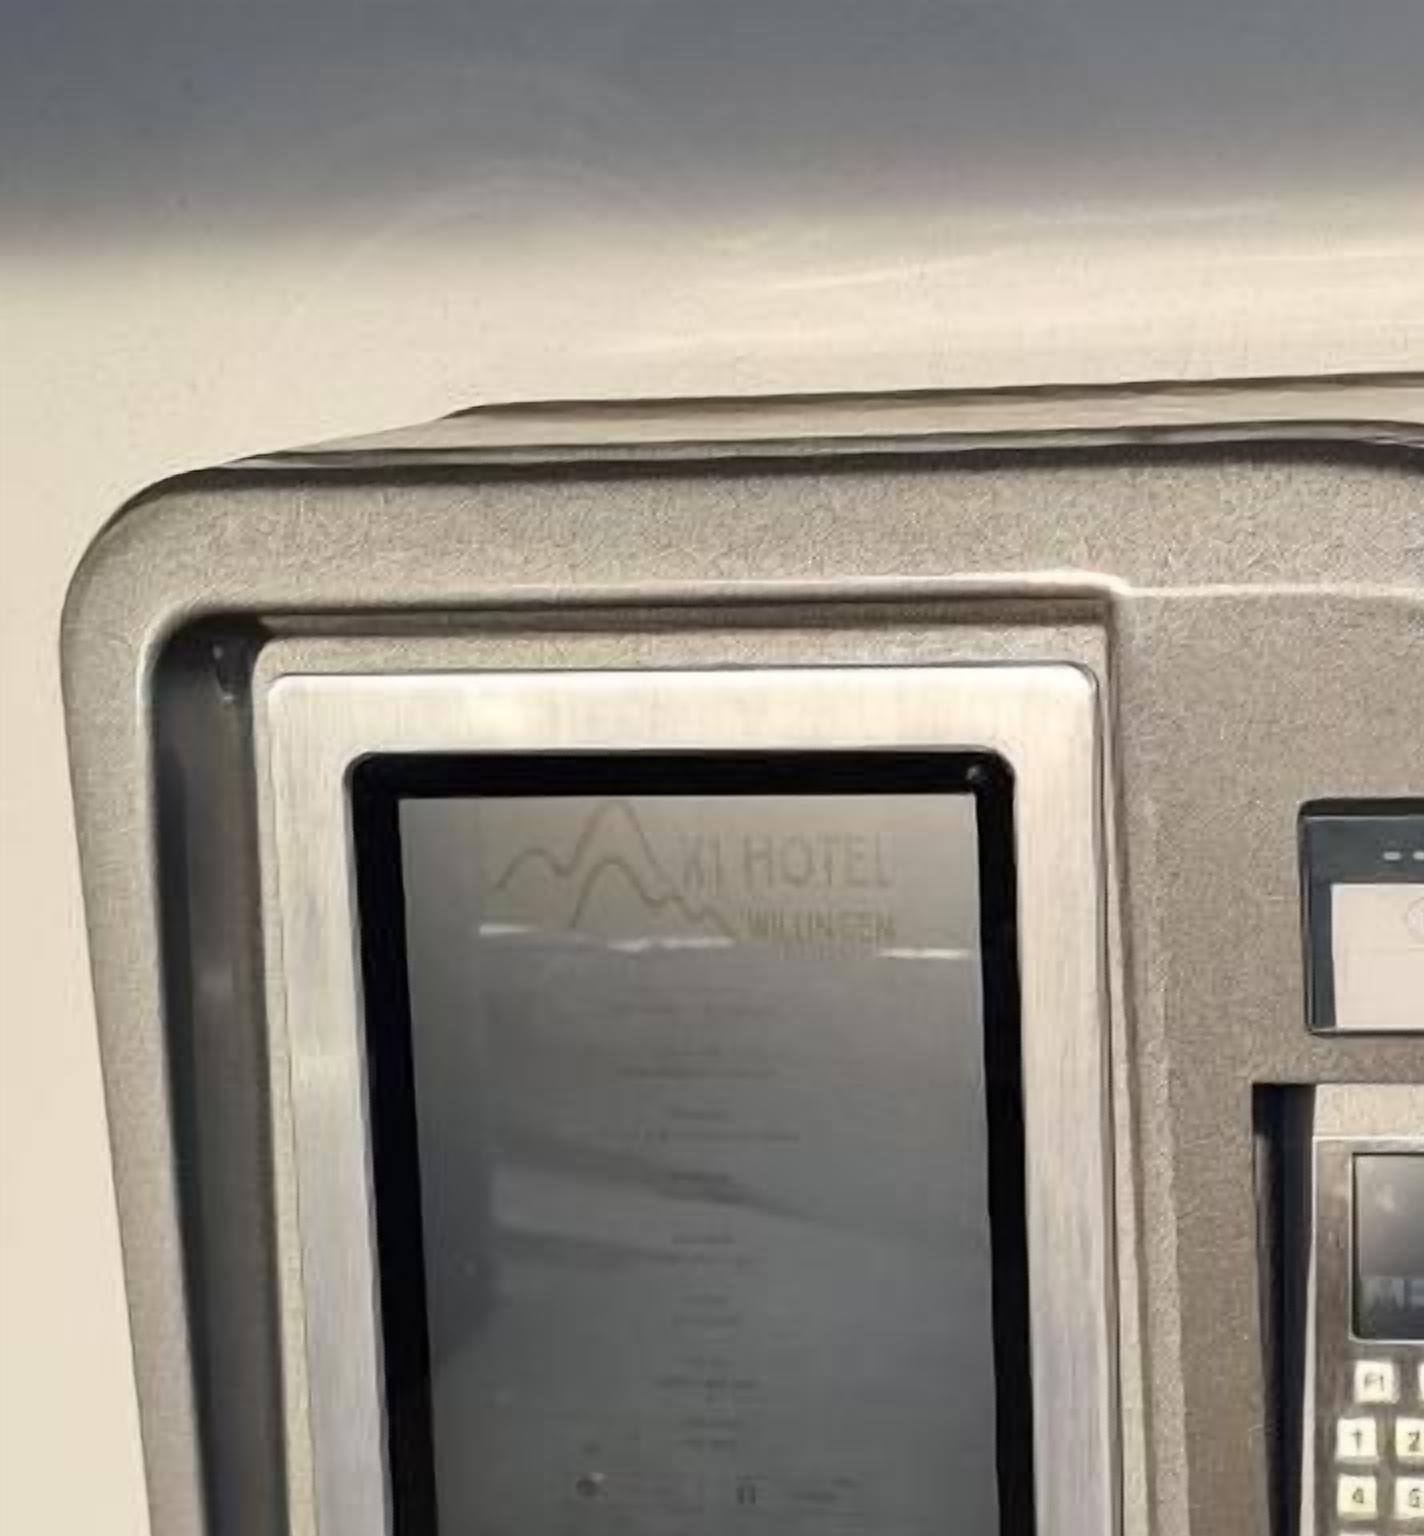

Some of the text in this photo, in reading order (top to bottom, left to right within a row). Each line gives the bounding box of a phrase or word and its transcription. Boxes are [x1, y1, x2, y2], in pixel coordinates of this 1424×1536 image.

[742, 836, 892, 888] HOTEL
[1364, 1372, 1385, 1389] F1
[1350, 1429, 1363, 1448] 1
[1407, 1431, 1421, 1451] 2
[1351, 1487, 1365, 1506] 4
[1408, 1487, 1421, 1508] 5
